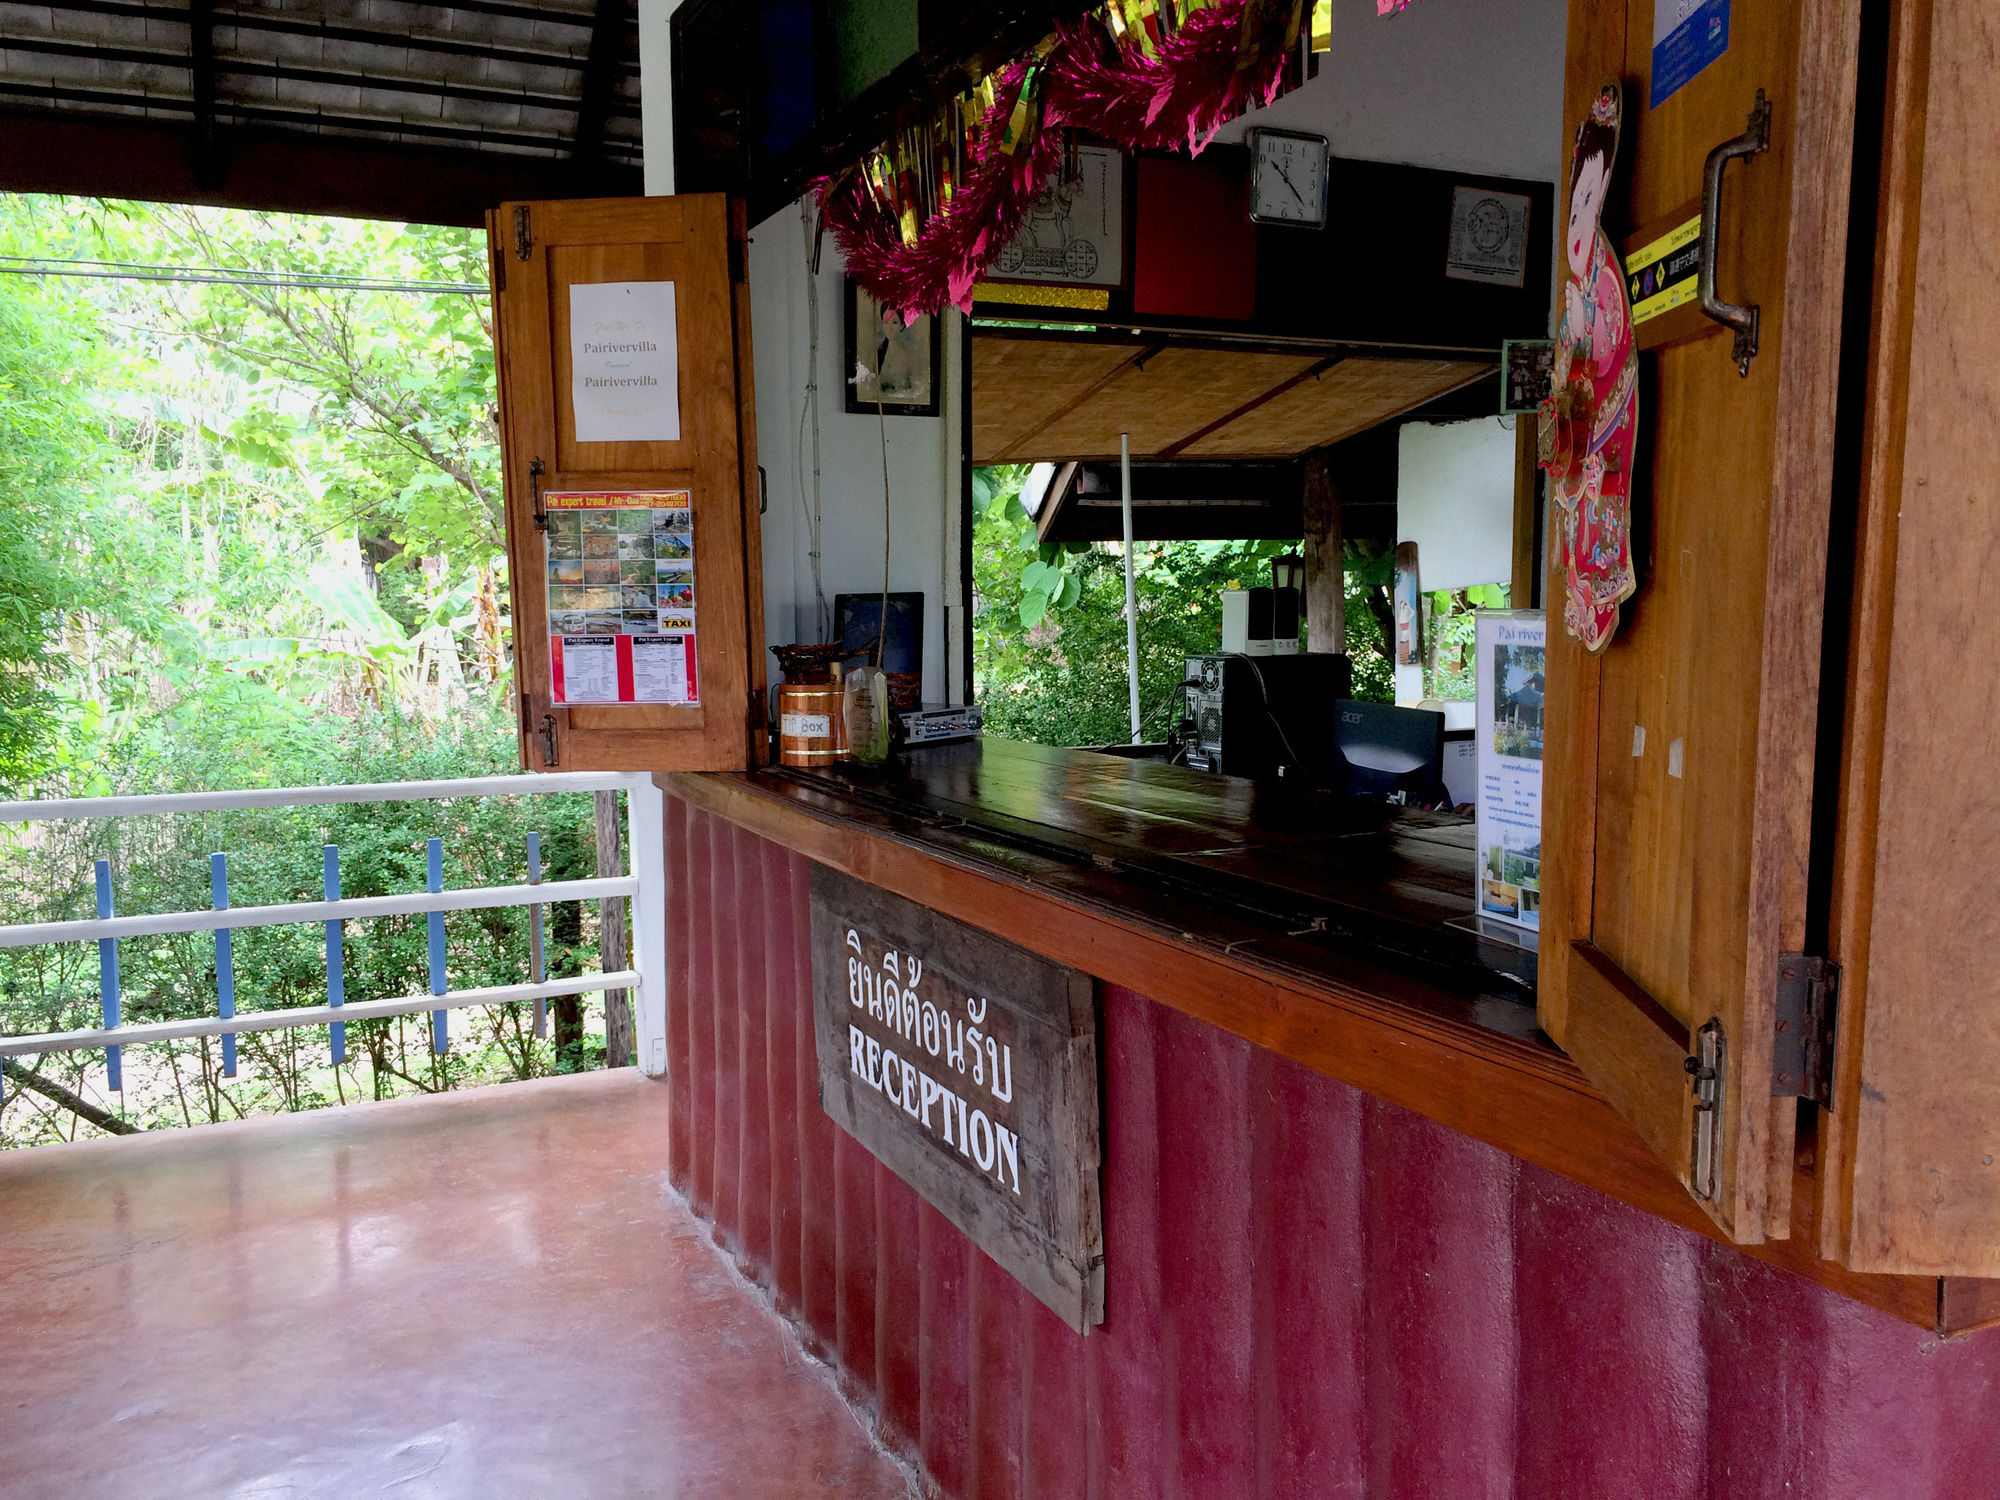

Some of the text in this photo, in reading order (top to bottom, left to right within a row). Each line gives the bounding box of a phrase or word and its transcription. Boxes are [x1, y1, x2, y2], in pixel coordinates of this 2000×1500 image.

[1268, 142, 1275, 153] 11
[1283, 143, 1292, 154] 12
[584, 341, 657, 353] Pairivervilla
[585, 375, 658, 387] Pairivervilla
[561, 497, 583, 509] expert
[586, 495, 607, 506] travel
[663, 619, 691, 628] TAXI
[1499, 625, 1544, 640] Pai river
[1341, 711, 1364, 724] acer
[801, 717, 823, 733] Box
[847, 928, 1013, 1104] ยินดีต้อนรับ
[849, 1023, 1021, 1196] RECEPTION
